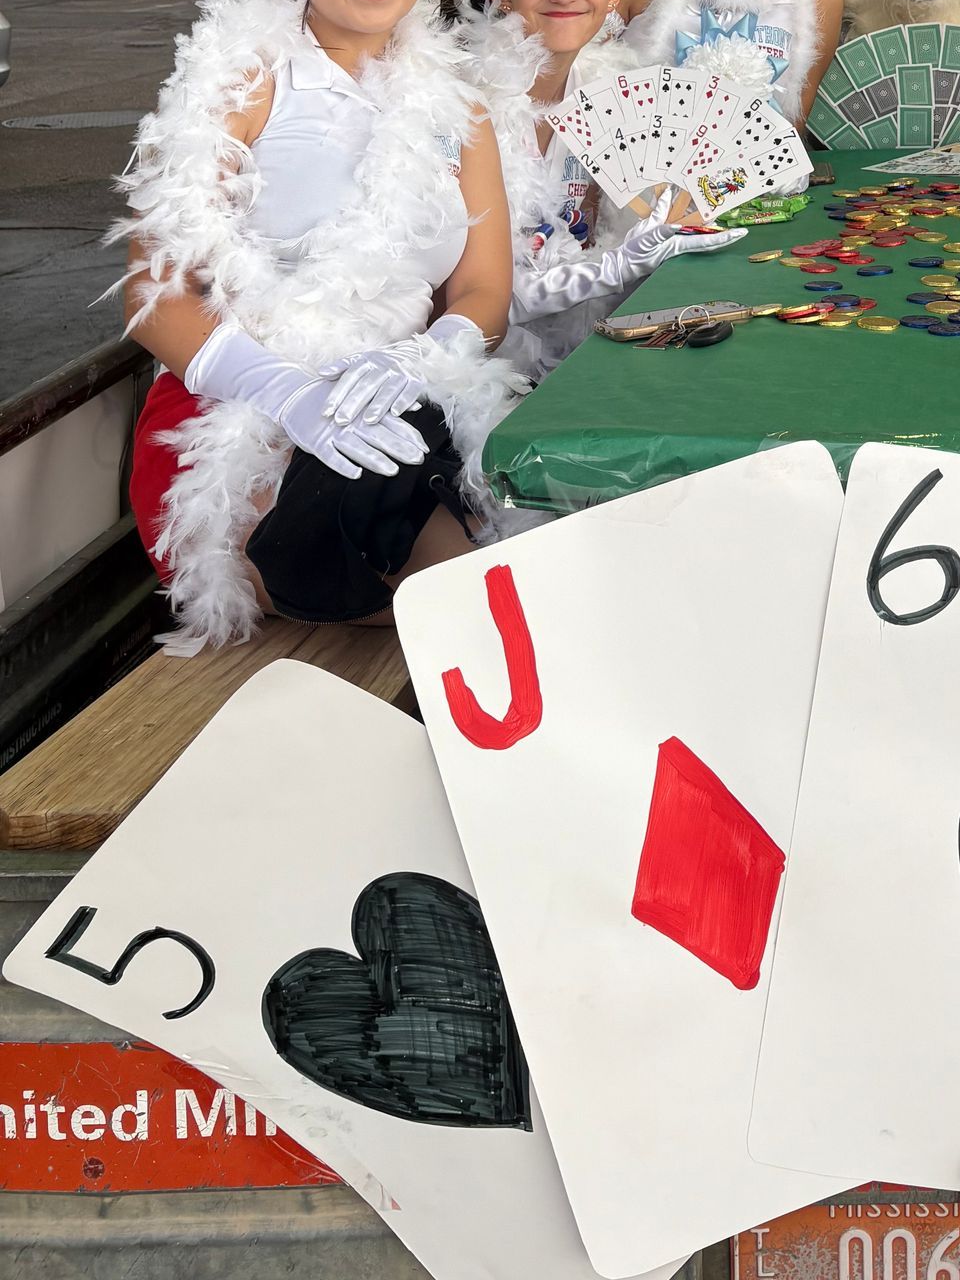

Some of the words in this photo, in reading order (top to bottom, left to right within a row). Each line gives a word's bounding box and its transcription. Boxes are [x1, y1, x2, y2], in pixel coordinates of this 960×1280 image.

[617, 75, 628, 89] 6
[662, 68, 672, 82] 5
[708, 75, 720, 90] 3
[579, 89, 589, 103] A
[750, 98, 763, 112] 6
[652, 114, 663, 129] 3
[614, 127, 625, 141] 4
[783, 130, 797, 139] 7
[580, 153, 594, 168] 2
[441, 564, 544, 750] J
[44, 905, 216, 1019] 5
